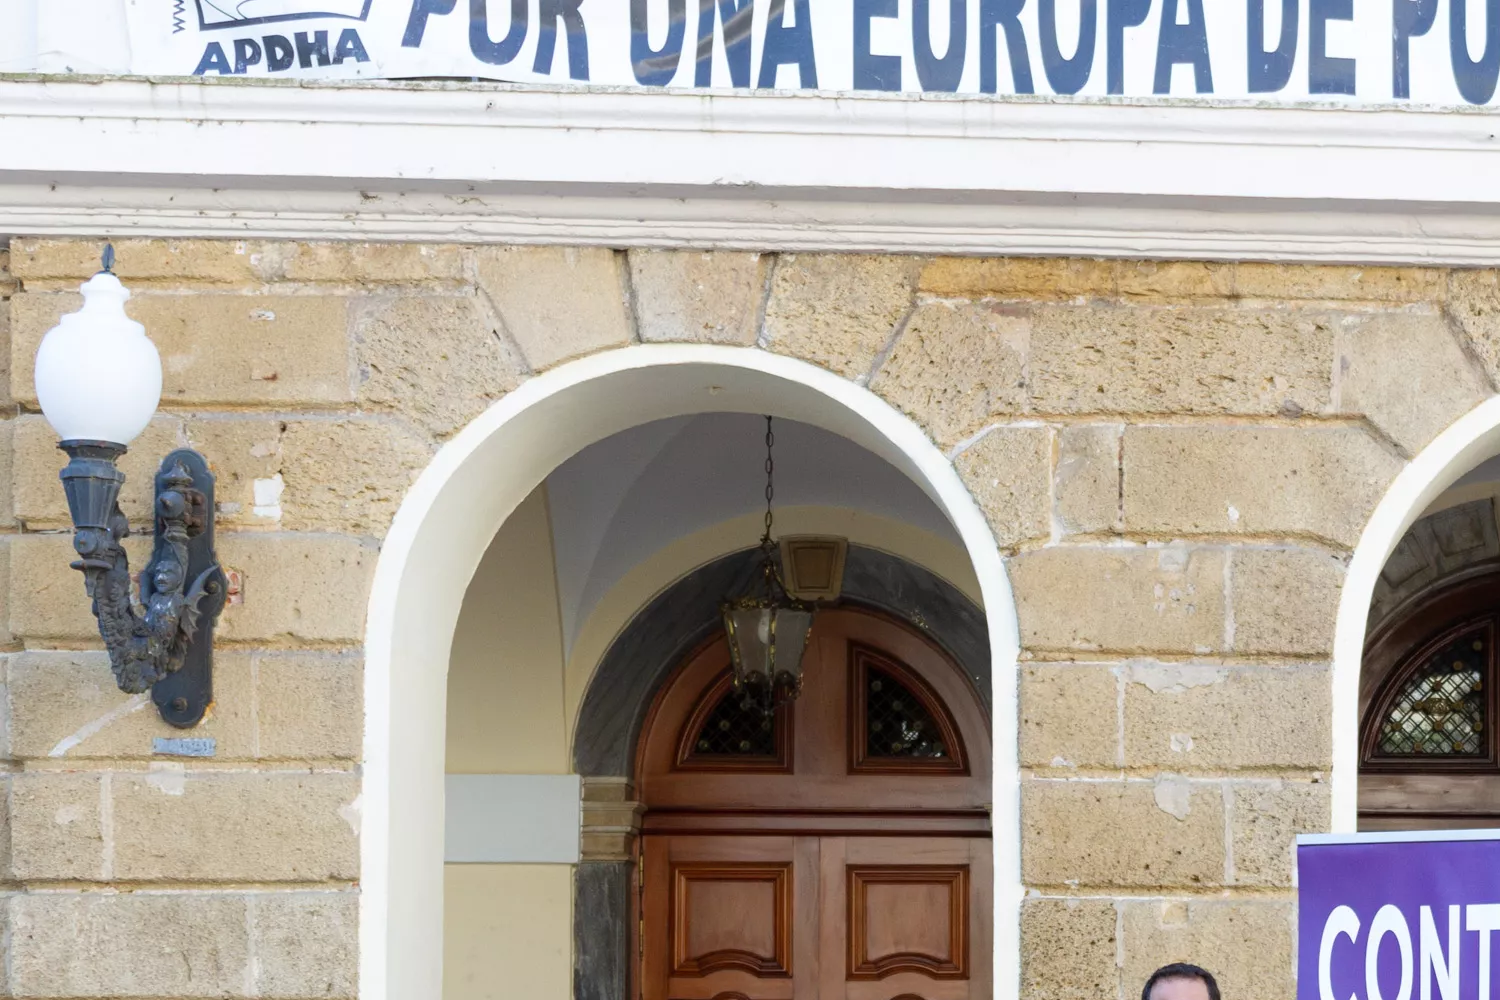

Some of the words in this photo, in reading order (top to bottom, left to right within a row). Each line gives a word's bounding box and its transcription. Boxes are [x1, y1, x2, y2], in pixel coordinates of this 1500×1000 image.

[191, 28, 372, 76] APDHA
[852, 0, 1214, 95] EUROPA
[1246, 0, 1357, 96] DE
